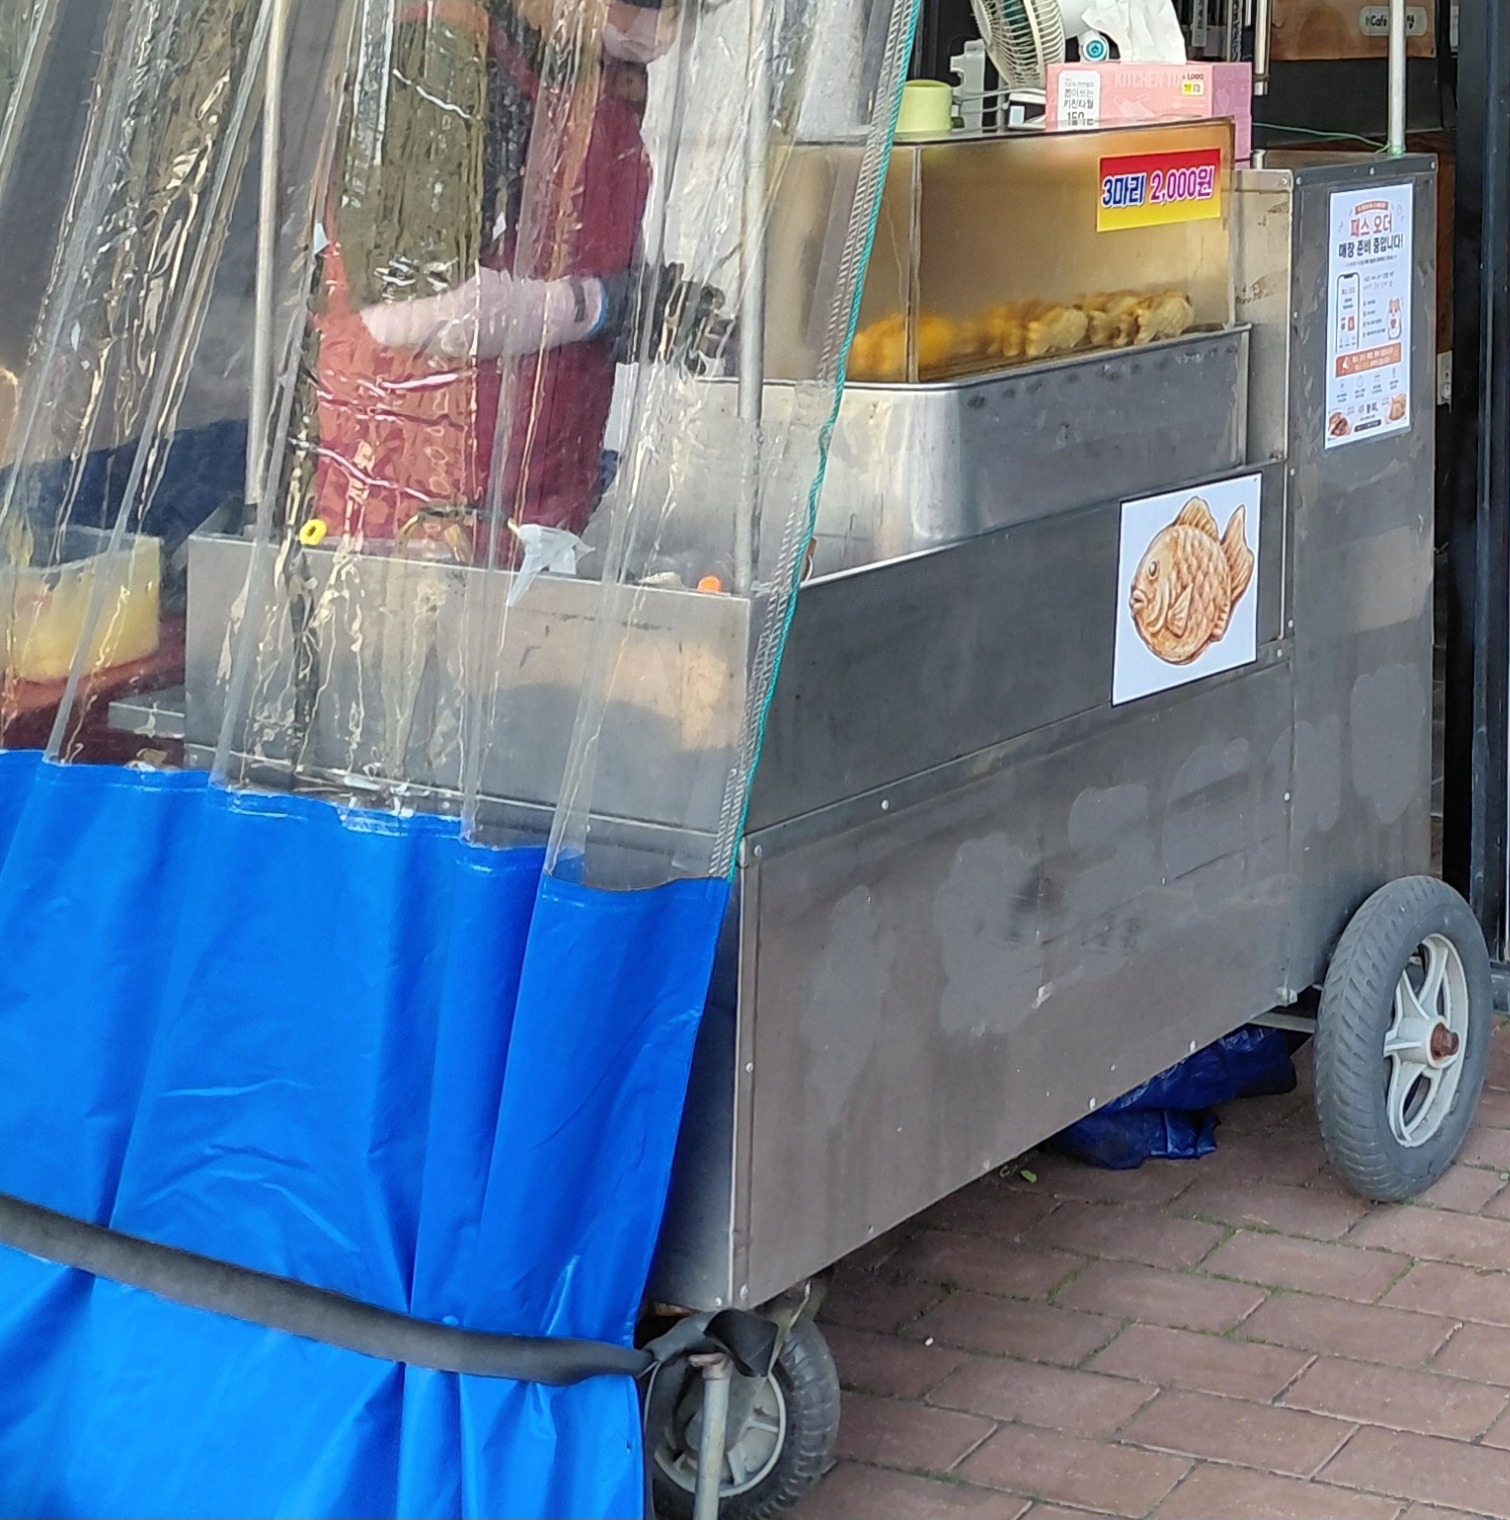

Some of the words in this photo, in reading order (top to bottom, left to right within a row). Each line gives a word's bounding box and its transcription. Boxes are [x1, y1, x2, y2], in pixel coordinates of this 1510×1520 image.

[1063, 98, 1094, 110] 키친타월
[1101, 171, 1147, 208] 3마리
[1149, 165, 1215, 206] 2,000원
[1350, 217, 1370, 237] 패스
[1372, 213, 1392, 234] 오더
[1338, 241, 1355, 259] 매장
[1356, 238, 1372, 257] 준비
[1373, 233, 1404, 254] 중입니다!
